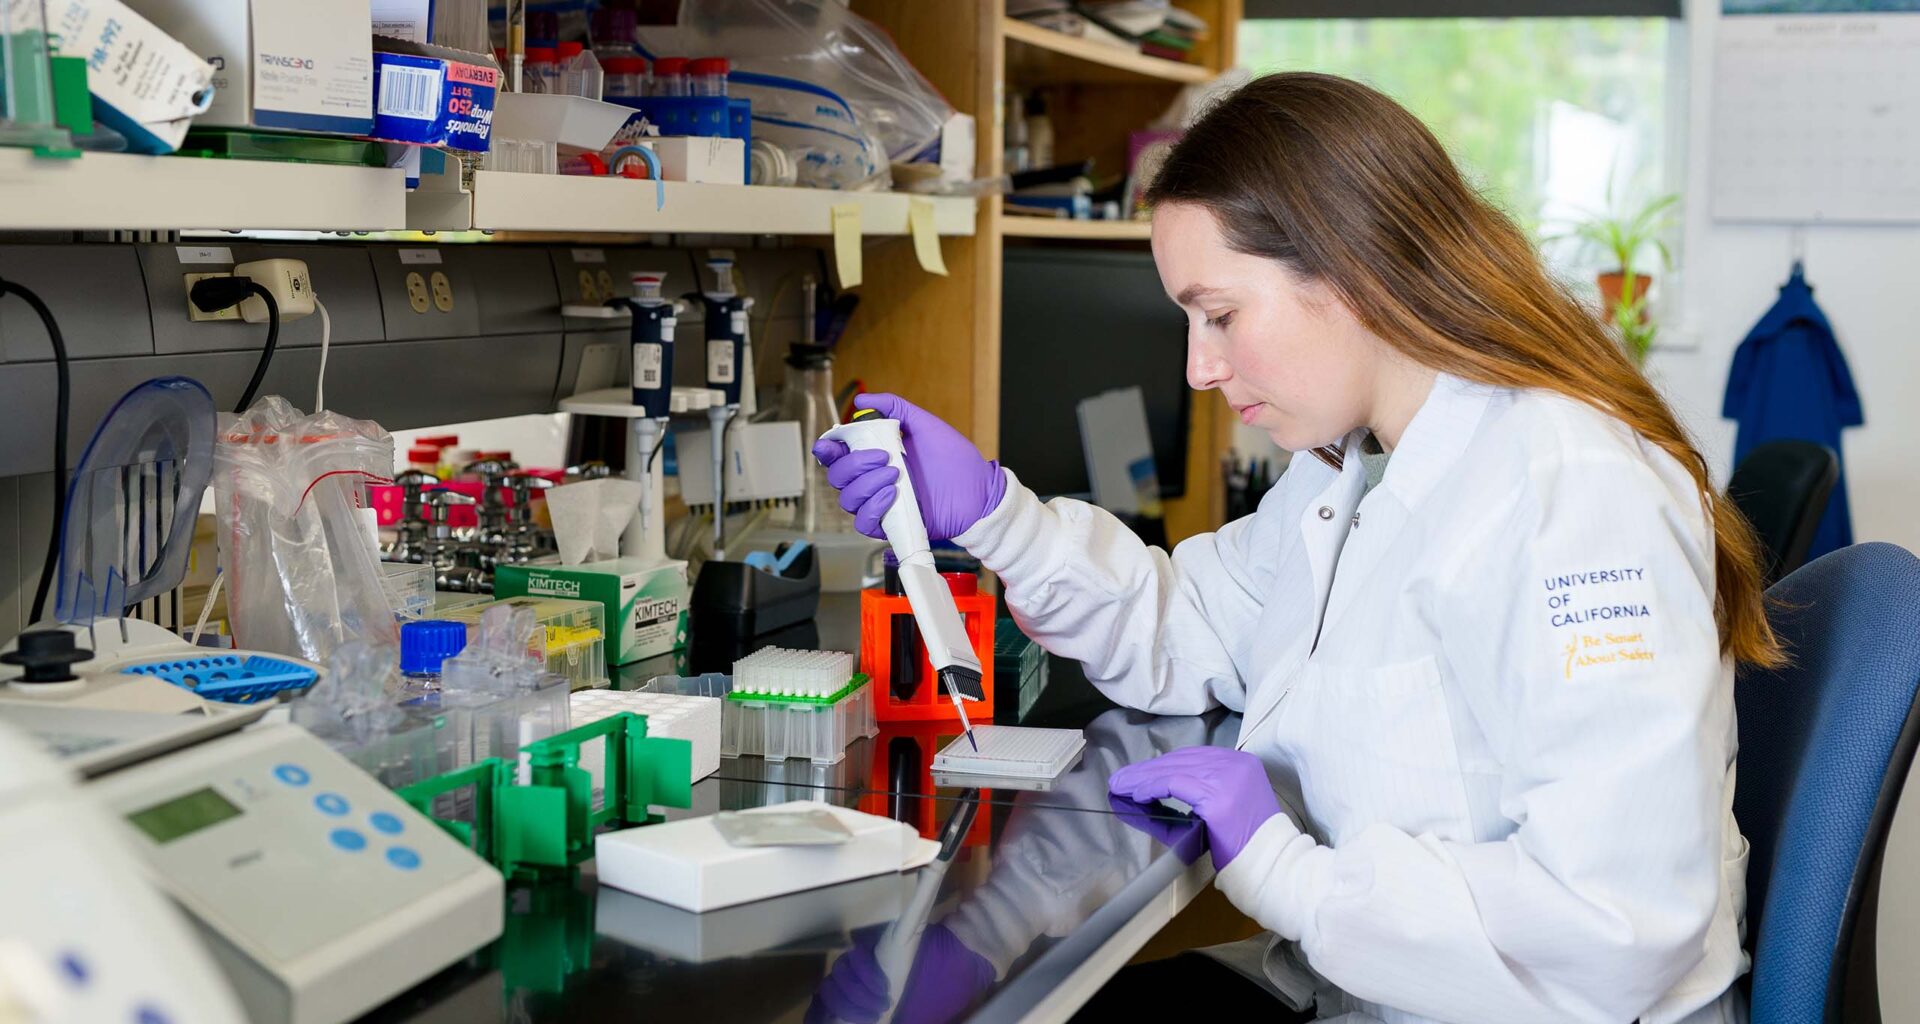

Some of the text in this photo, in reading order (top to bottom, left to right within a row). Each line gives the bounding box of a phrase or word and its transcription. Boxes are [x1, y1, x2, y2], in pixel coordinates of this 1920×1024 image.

[455, 66, 493, 83] EVERYDAY
[451, 86, 462, 97] FT
[448, 98, 473, 115] 250
[470, 104, 493, 125] Wrap
[445, 119, 490, 140] Reynolds
[528, 577, 580, 593] KIMTECH
[1545, 568, 1644, 591] UNIVERSITY
[1548, 594, 1571, 609] OF
[635, 599, 678, 622] KIMTECH
[1551, 605, 1650, 627] CALIFORNIA
[1583, 632, 1644, 648] Be Smart
[1576, 649, 1656, 667] About Safety
